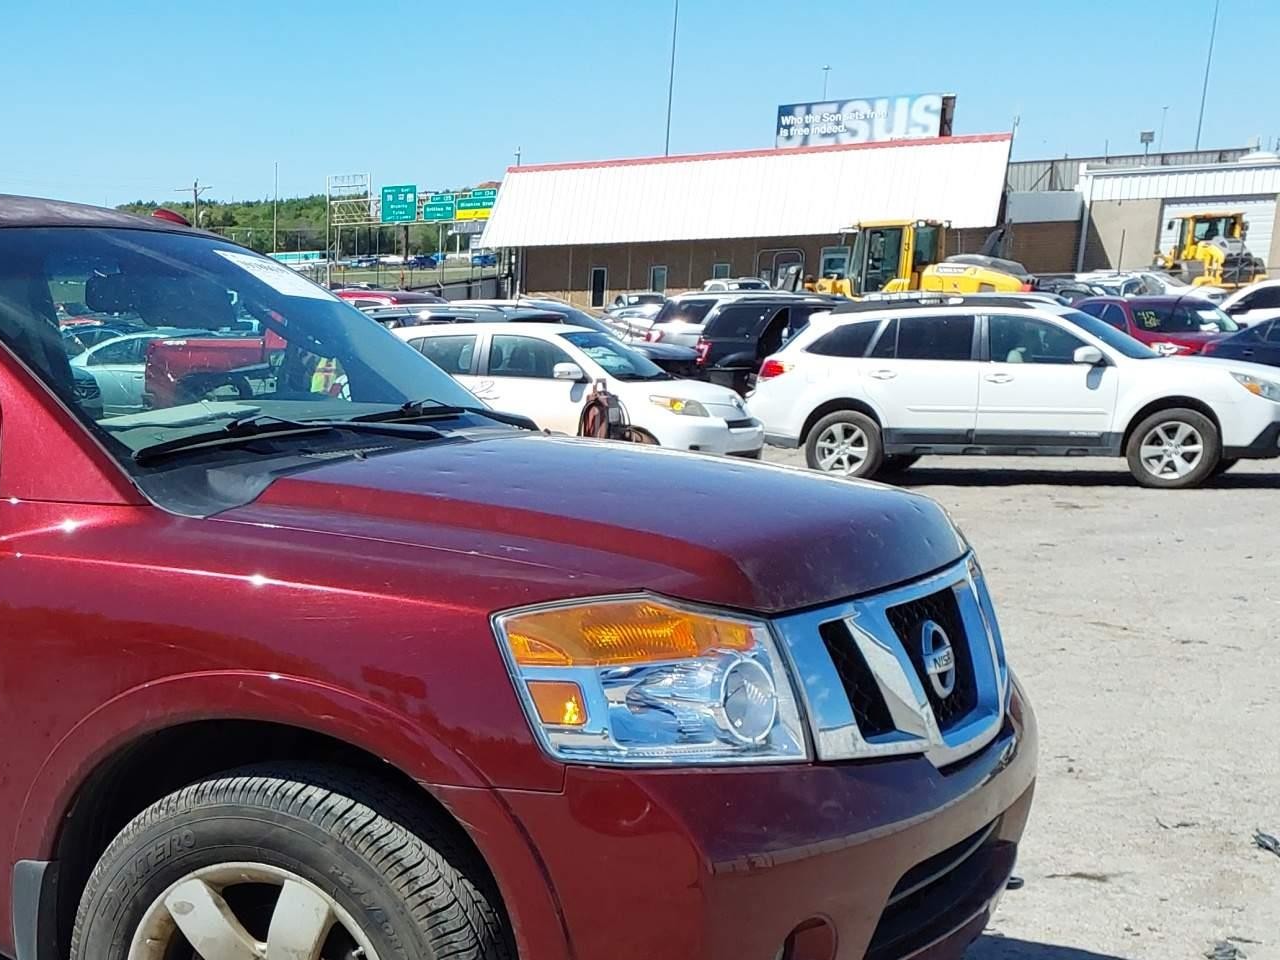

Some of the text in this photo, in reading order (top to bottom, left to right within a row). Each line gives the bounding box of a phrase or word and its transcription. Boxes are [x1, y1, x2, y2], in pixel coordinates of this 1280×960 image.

[776, 94, 942, 147] JESUS
[781, 108, 889, 126] Who the Son sets free
[780, 123, 847, 137] is free indeed.
